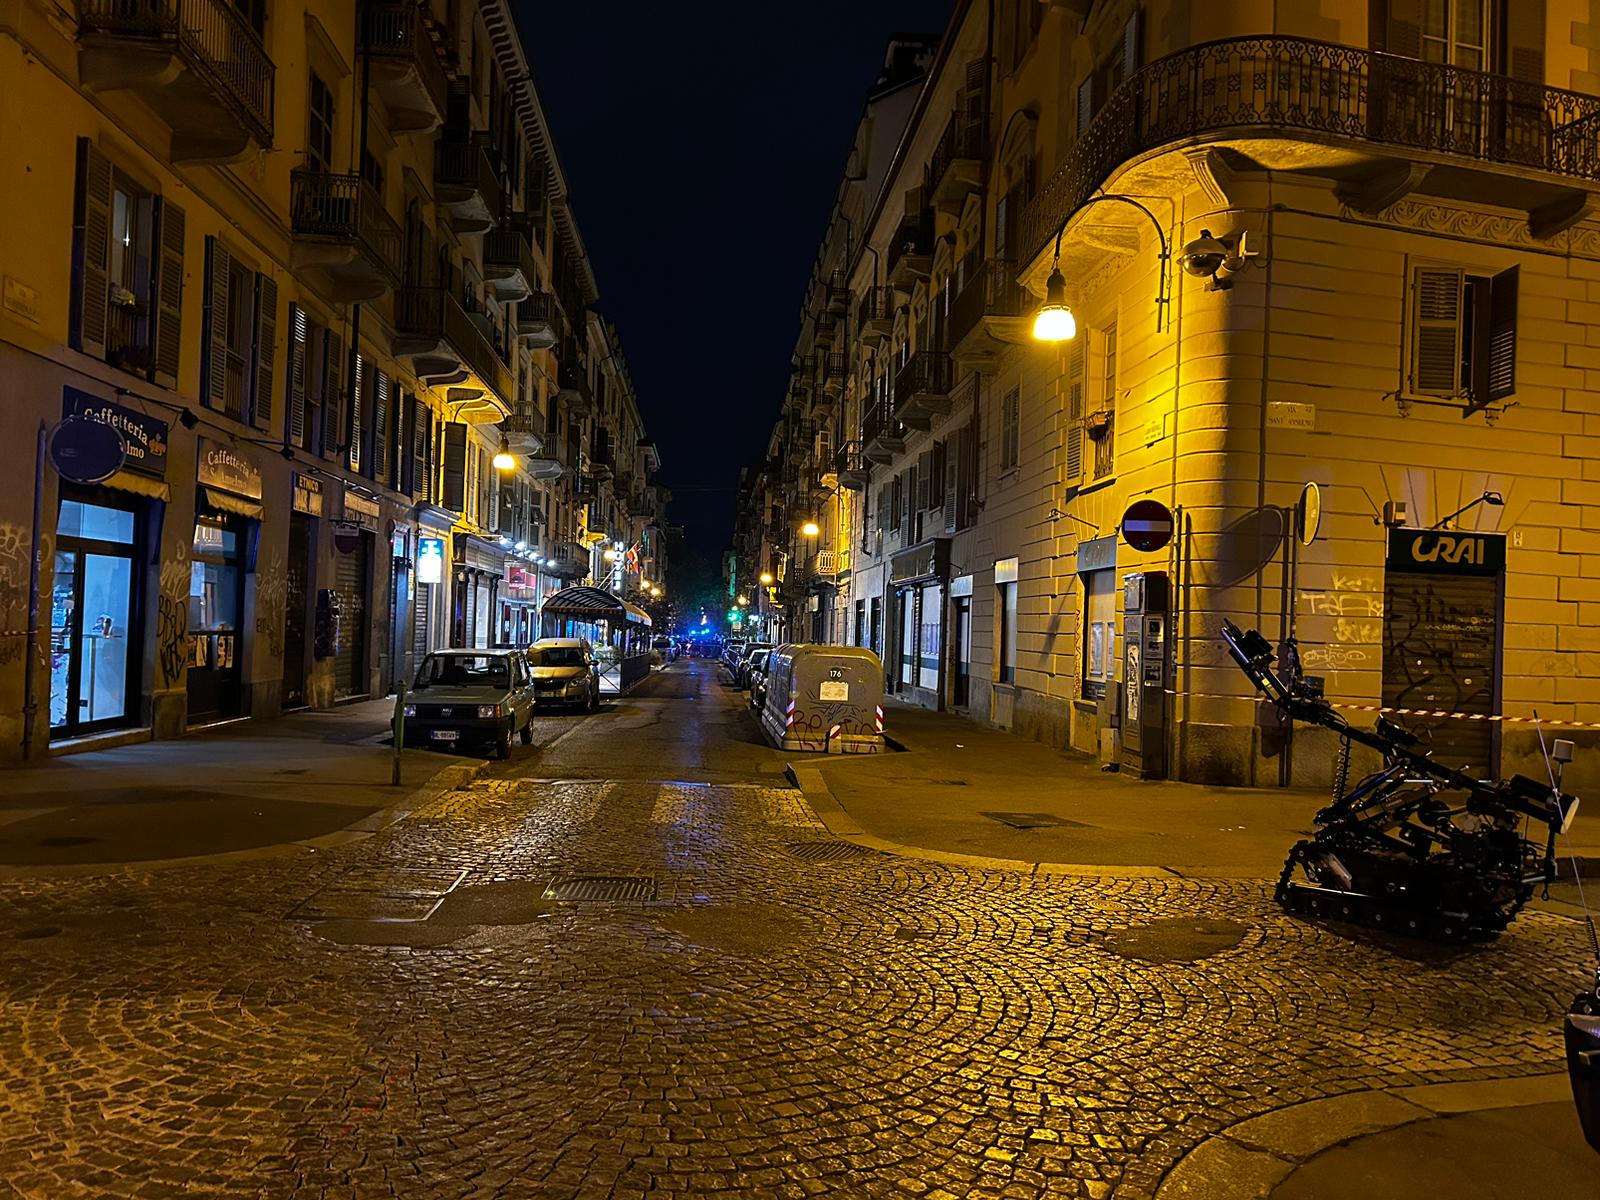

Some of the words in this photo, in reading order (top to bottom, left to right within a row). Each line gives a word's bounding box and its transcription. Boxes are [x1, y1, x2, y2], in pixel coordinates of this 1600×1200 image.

[208, 449, 250, 479] Caffetteria
[1411, 535, 1485, 565] CRAI
[829, 670, 842, 678] 176
